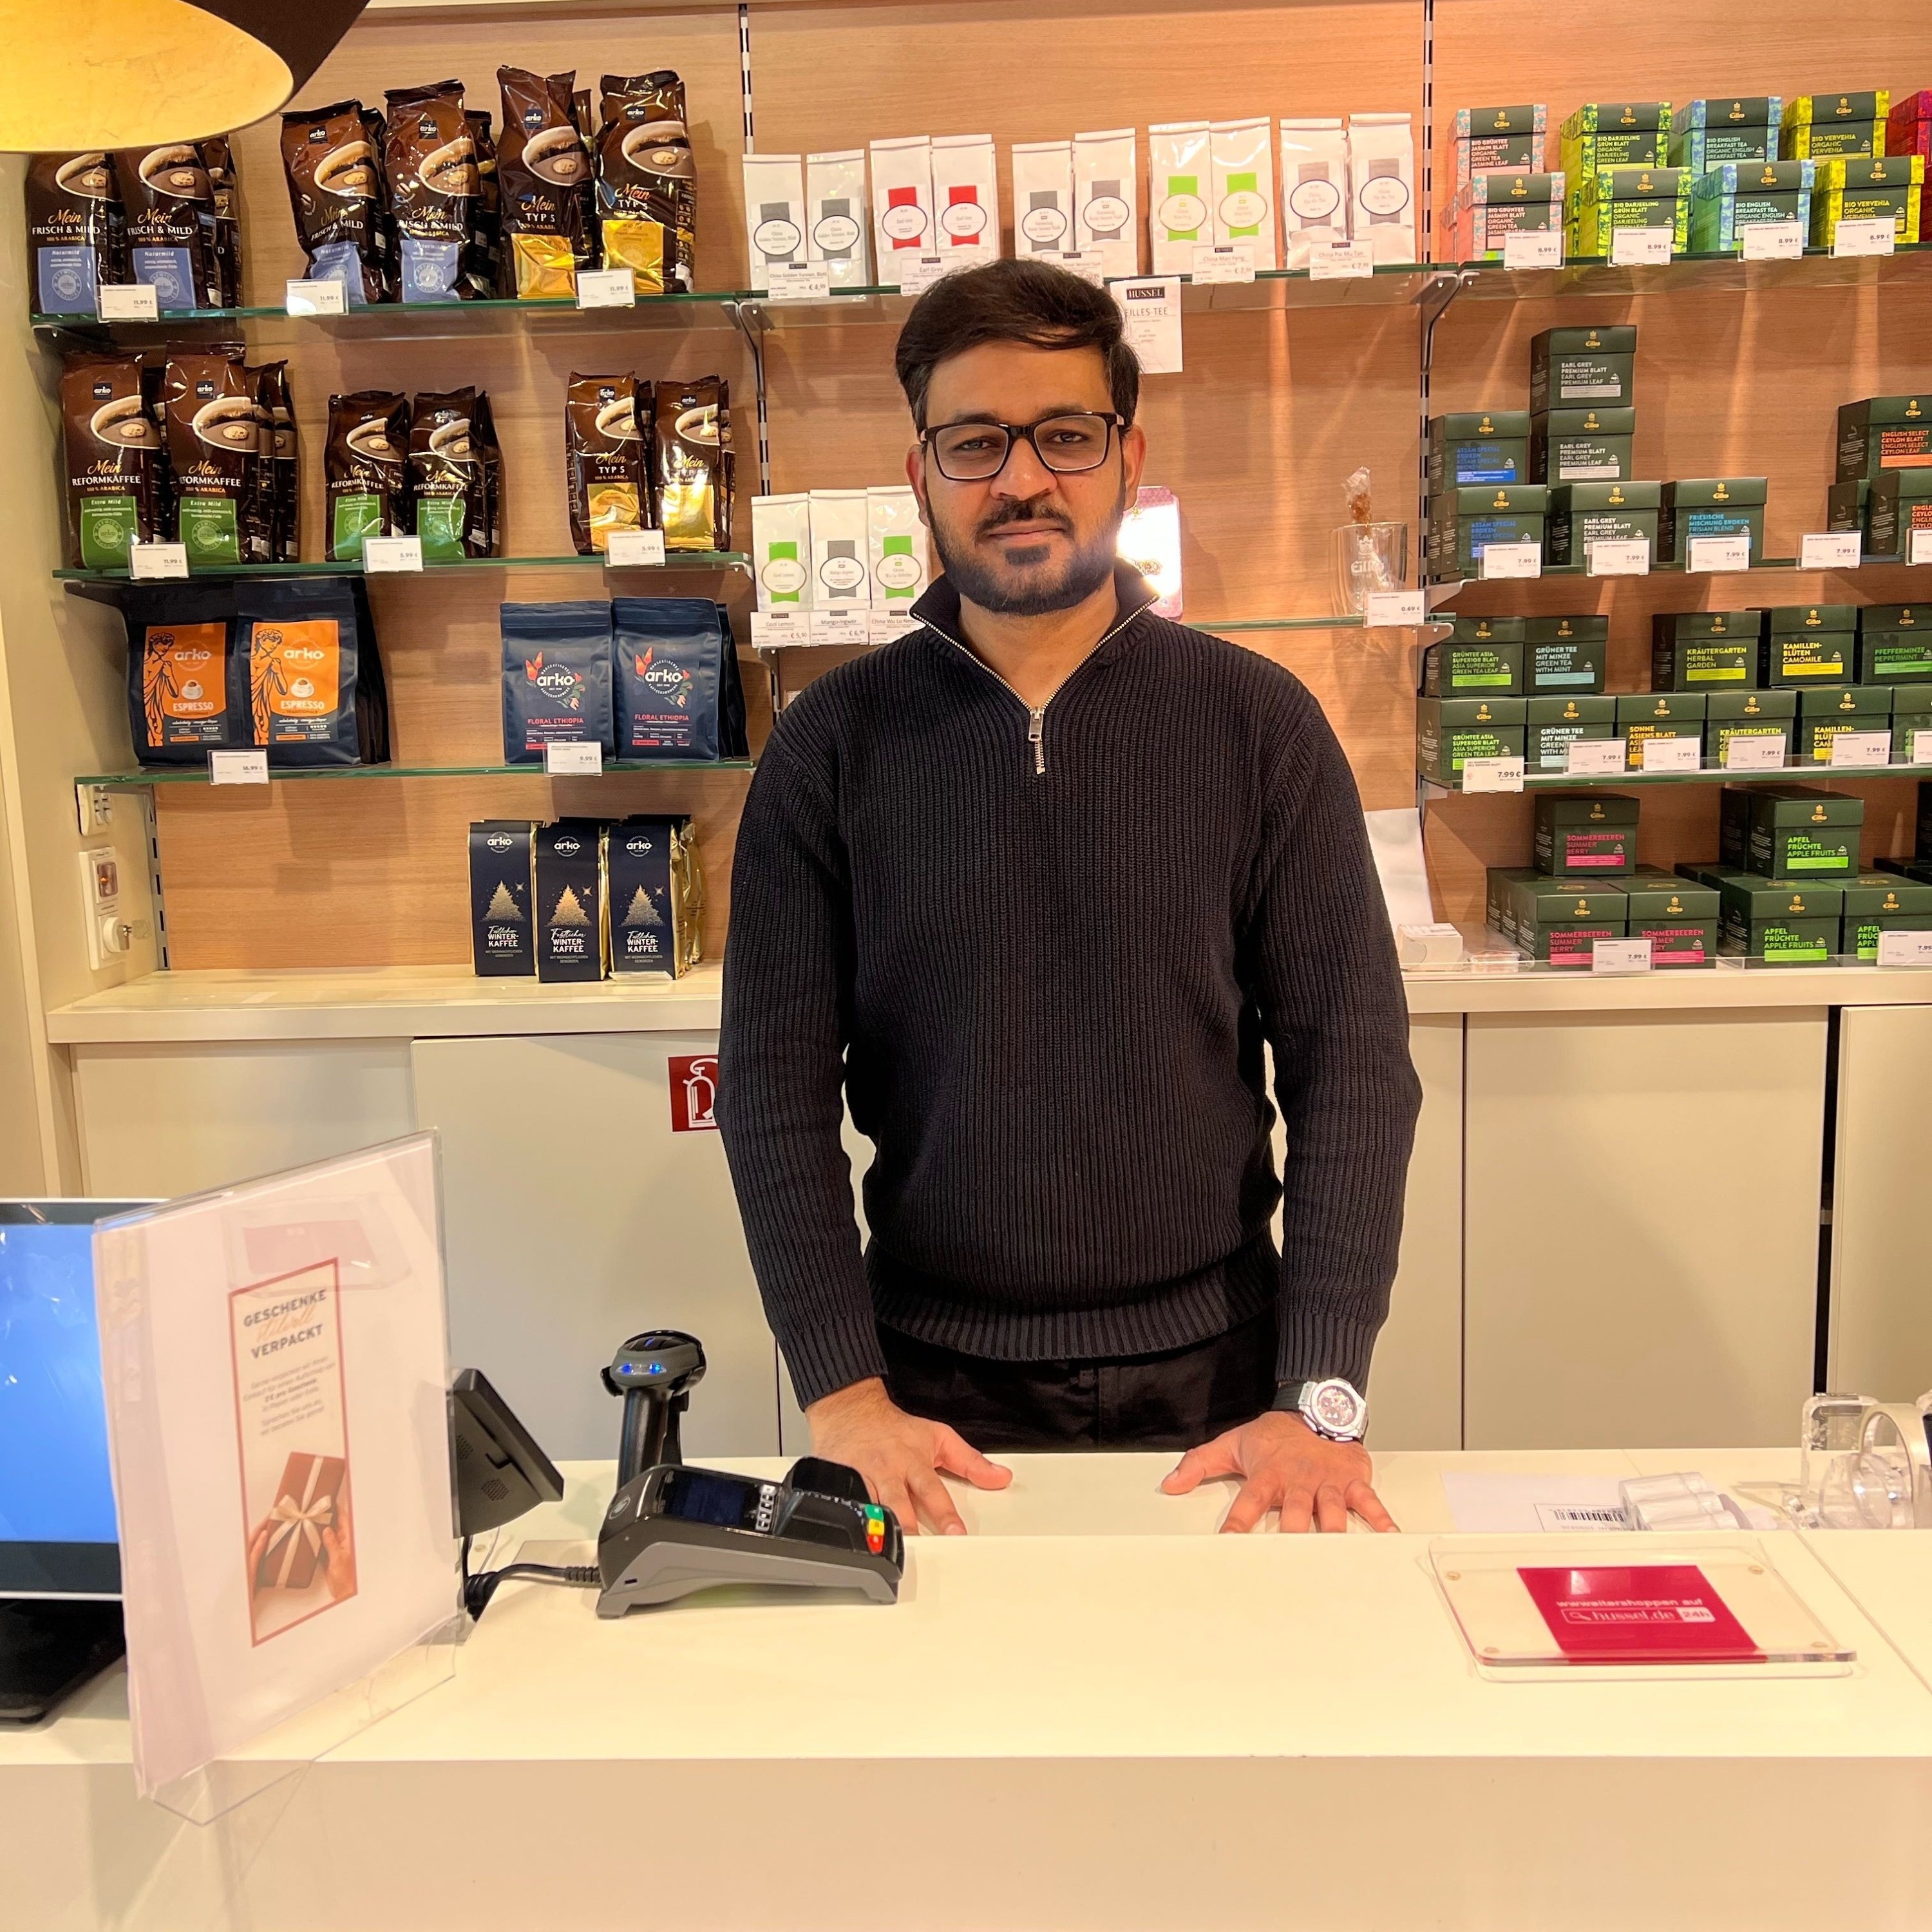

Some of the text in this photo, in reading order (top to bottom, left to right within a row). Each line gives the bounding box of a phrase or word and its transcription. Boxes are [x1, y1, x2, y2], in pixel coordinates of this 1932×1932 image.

[310, 129, 325, 138] arko
[614, 184, 651, 200] Mein
[521, 195, 556, 211] Mein
[48, 210, 82, 223] Mein
[137, 209, 172, 224] Mein
[525, 213, 547, 222] TYP
[32, 227, 64, 235] FRISCH
[167, 227, 193, 235] MILD
[1128, 289, 1163, 298] HUSSEL
[88, 460, 122, 475] Mein
[189, 460, 223, 475] Mein
[72, 475, 140, 486] REFORMKAFFEE
[175, 649, 212, 661] arko
[284, 647, 325, 659] arko
[1783, 649, 1811, 657] BLÜTEN
[536, 673, 575, 686] arko
[645, 669, 683, 683] arko
[173, 702, 214, 712] ESPRESSO
[281, 700, 325, 709] ESPRESSO
[488, 837, 513, 846] arko
[554, 842, 580, 850] arko
[626, 842, 652, 850] arko
[243, 1289, 327, 1327] GESCHENKE
[251, 1324, 323, 1358] VERPACKT
[1593, 1611, 1675, 1620] hussel.de
